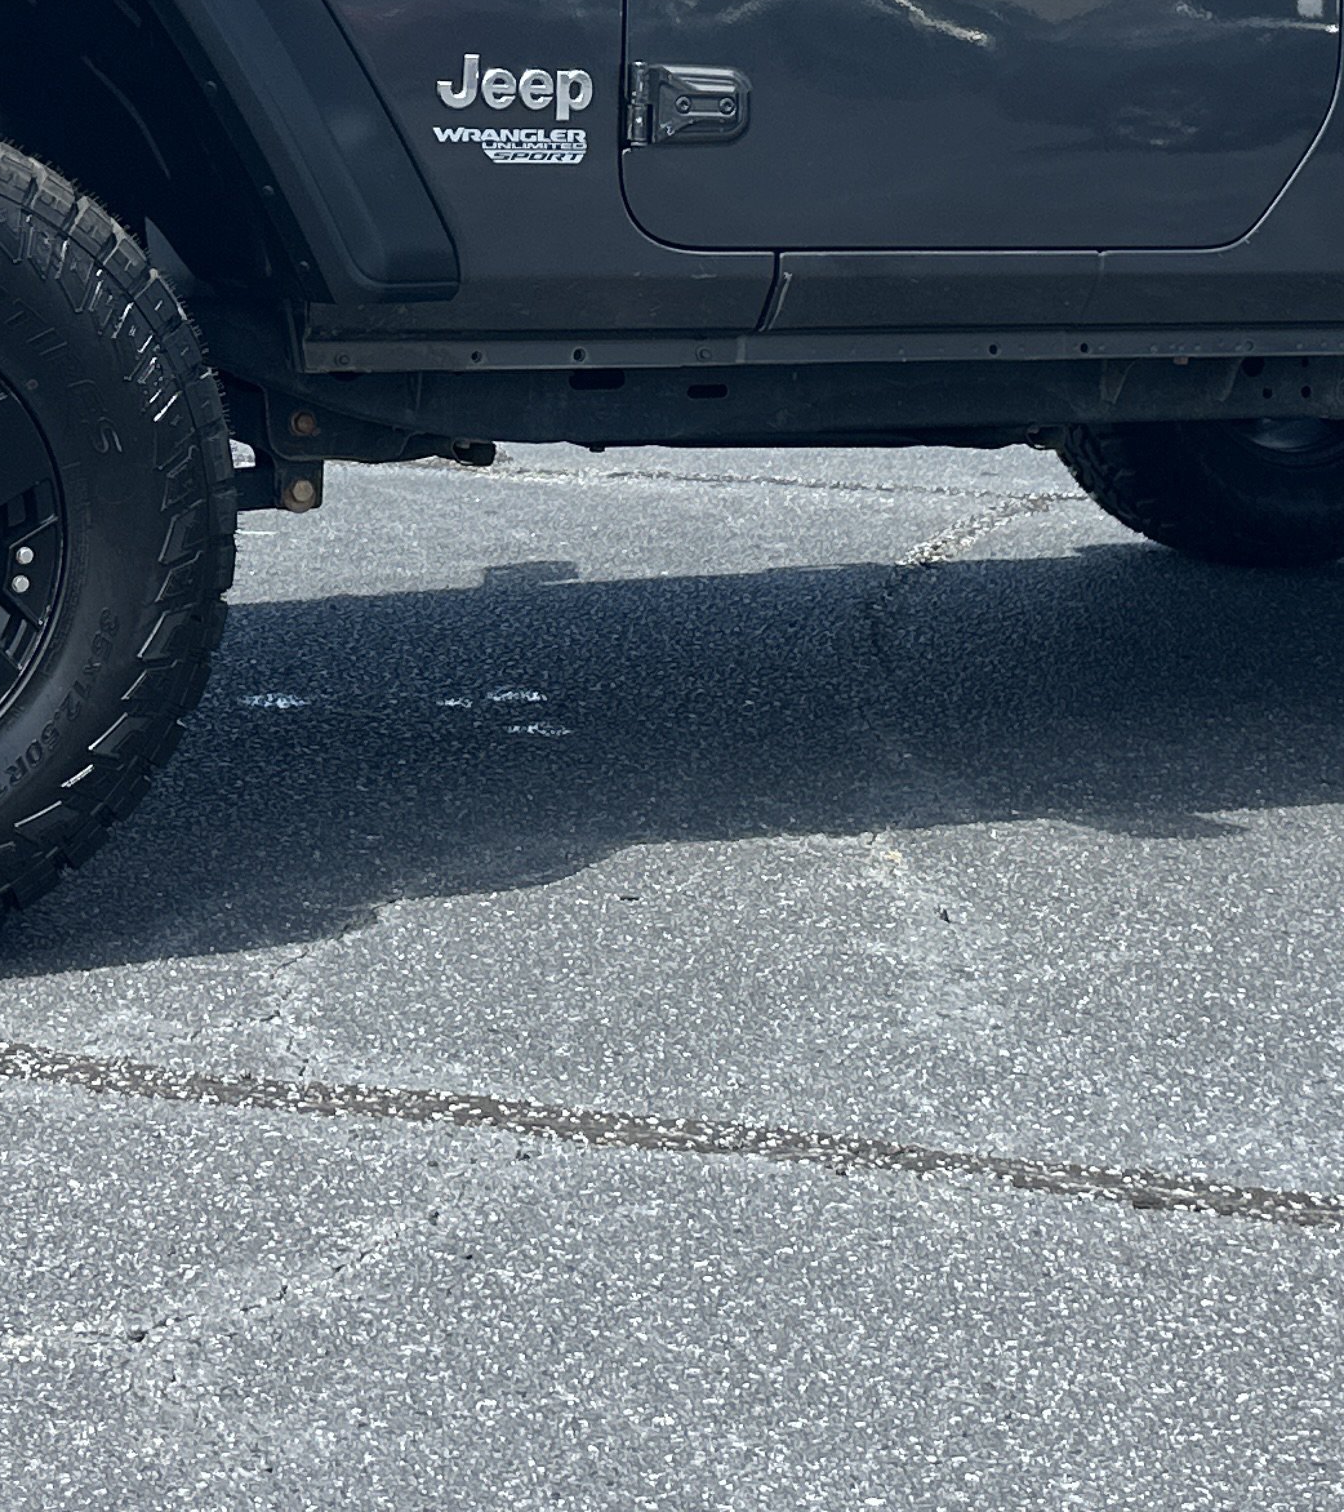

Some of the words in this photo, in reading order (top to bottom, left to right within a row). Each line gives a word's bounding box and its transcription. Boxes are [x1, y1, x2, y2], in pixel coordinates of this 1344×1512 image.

[436, 53, 593, 121] Jeep
[433, 127, 587, 143] WRANGLER
[482, 141, 587, 150] UNLIMITED
[494, 151, 582, 162] SPORT
